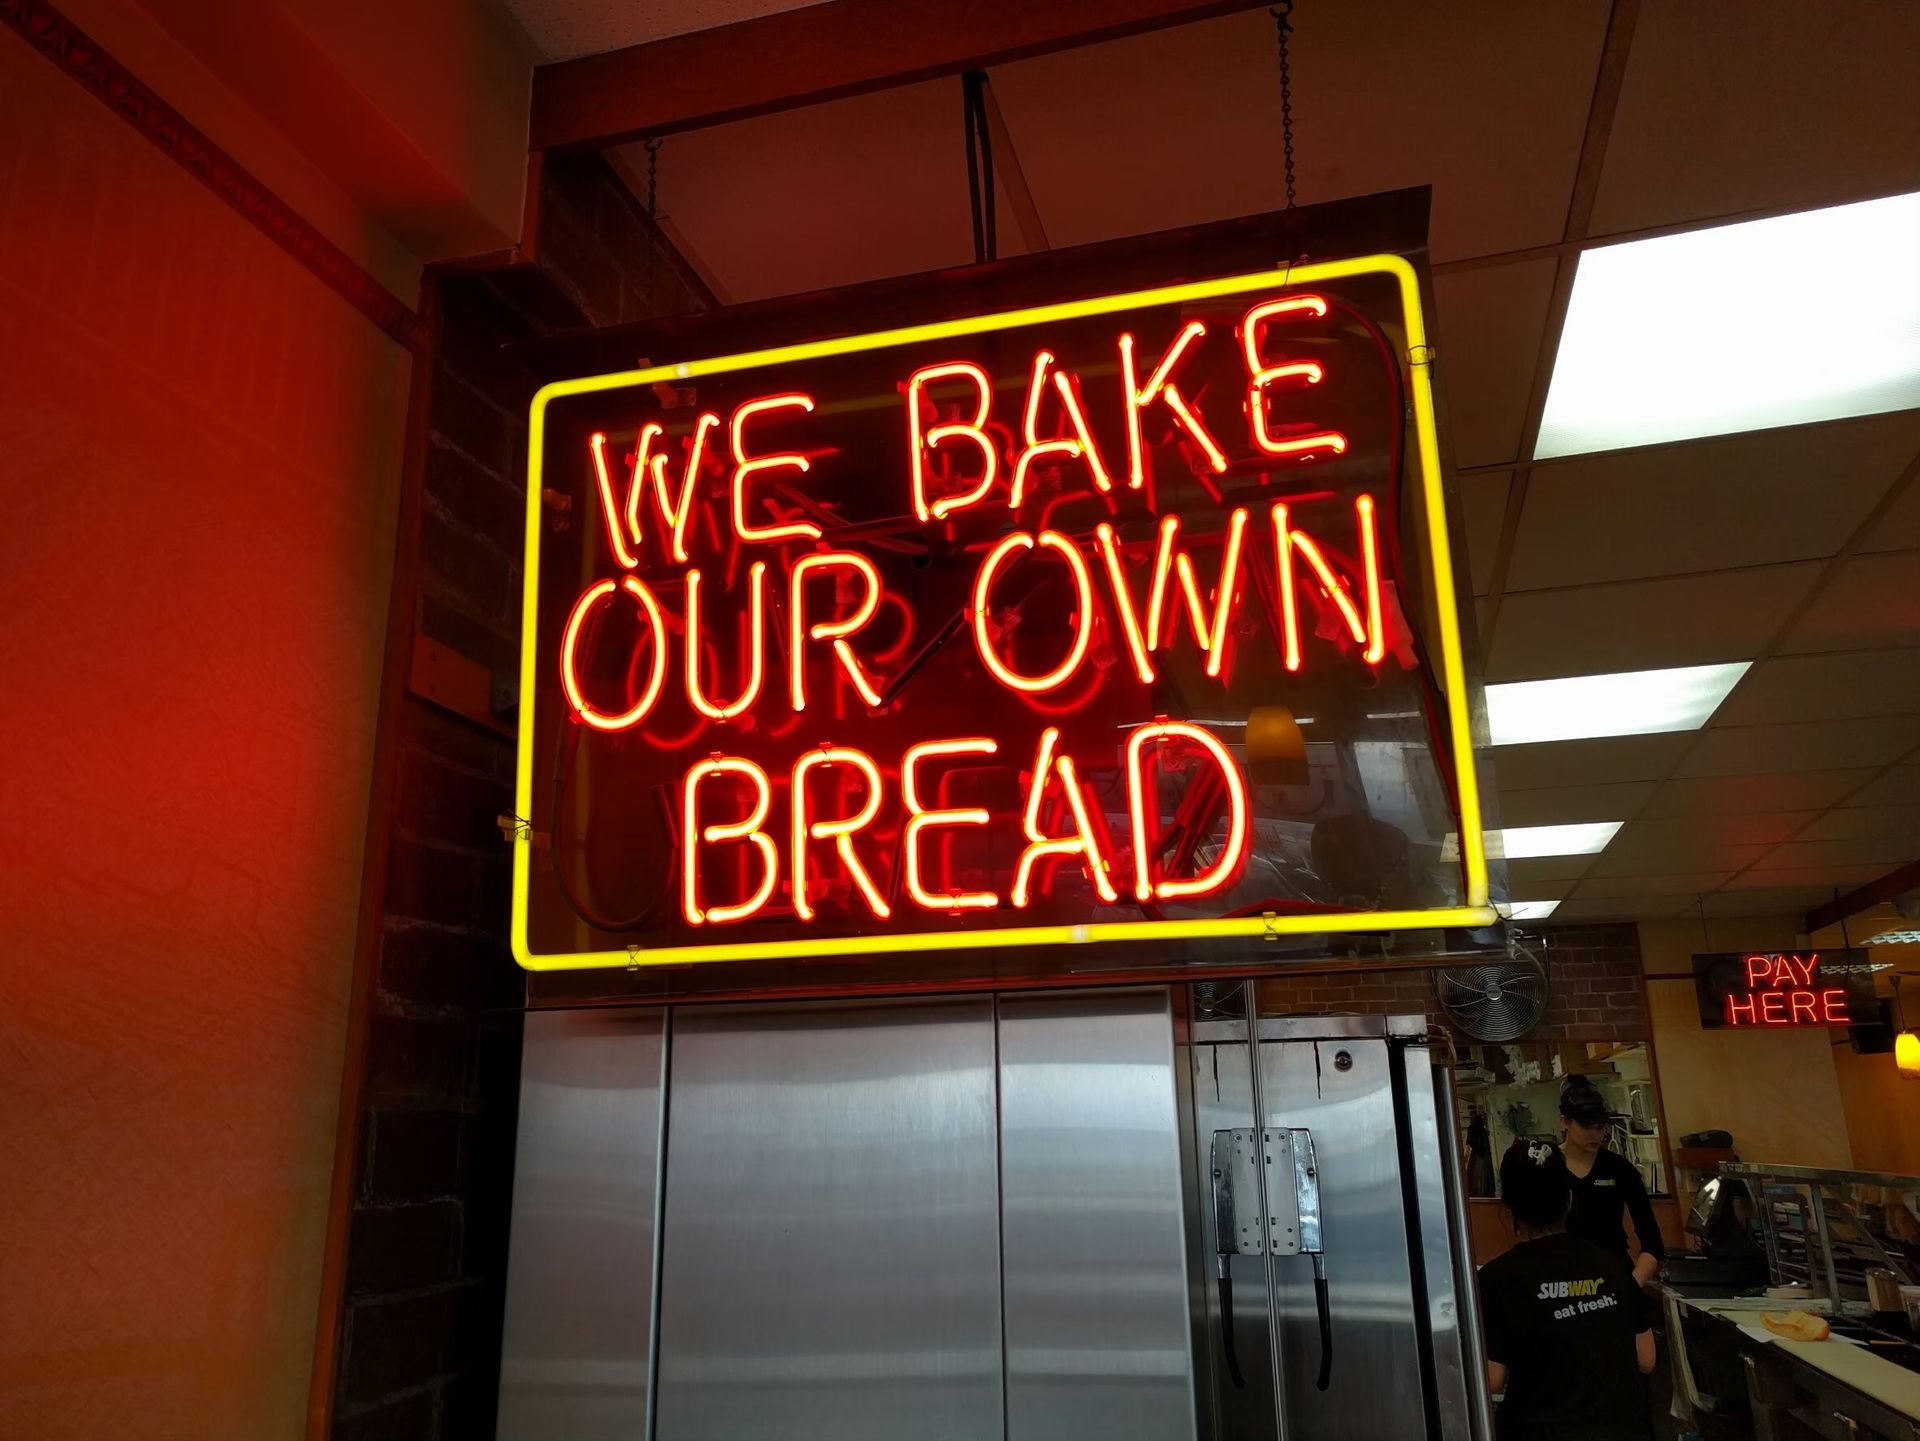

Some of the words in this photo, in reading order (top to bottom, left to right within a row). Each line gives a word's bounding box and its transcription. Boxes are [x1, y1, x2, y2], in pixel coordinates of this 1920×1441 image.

[589, 392, 823, 568] WE
[906, 293, 1347, 521] BAKE
[560, 550, 882, 730] OUR
[972, 493, 1385, 693] OWN
[682, 720, 1251, 926] BREAD
[1747, 953, 1818, 988] PAY
[1728, 989, 1851, 1025] HERE
[1536, 1276, 1605, 1300] SUBWAY
[1553, 1304, 1576, 1320] eat
